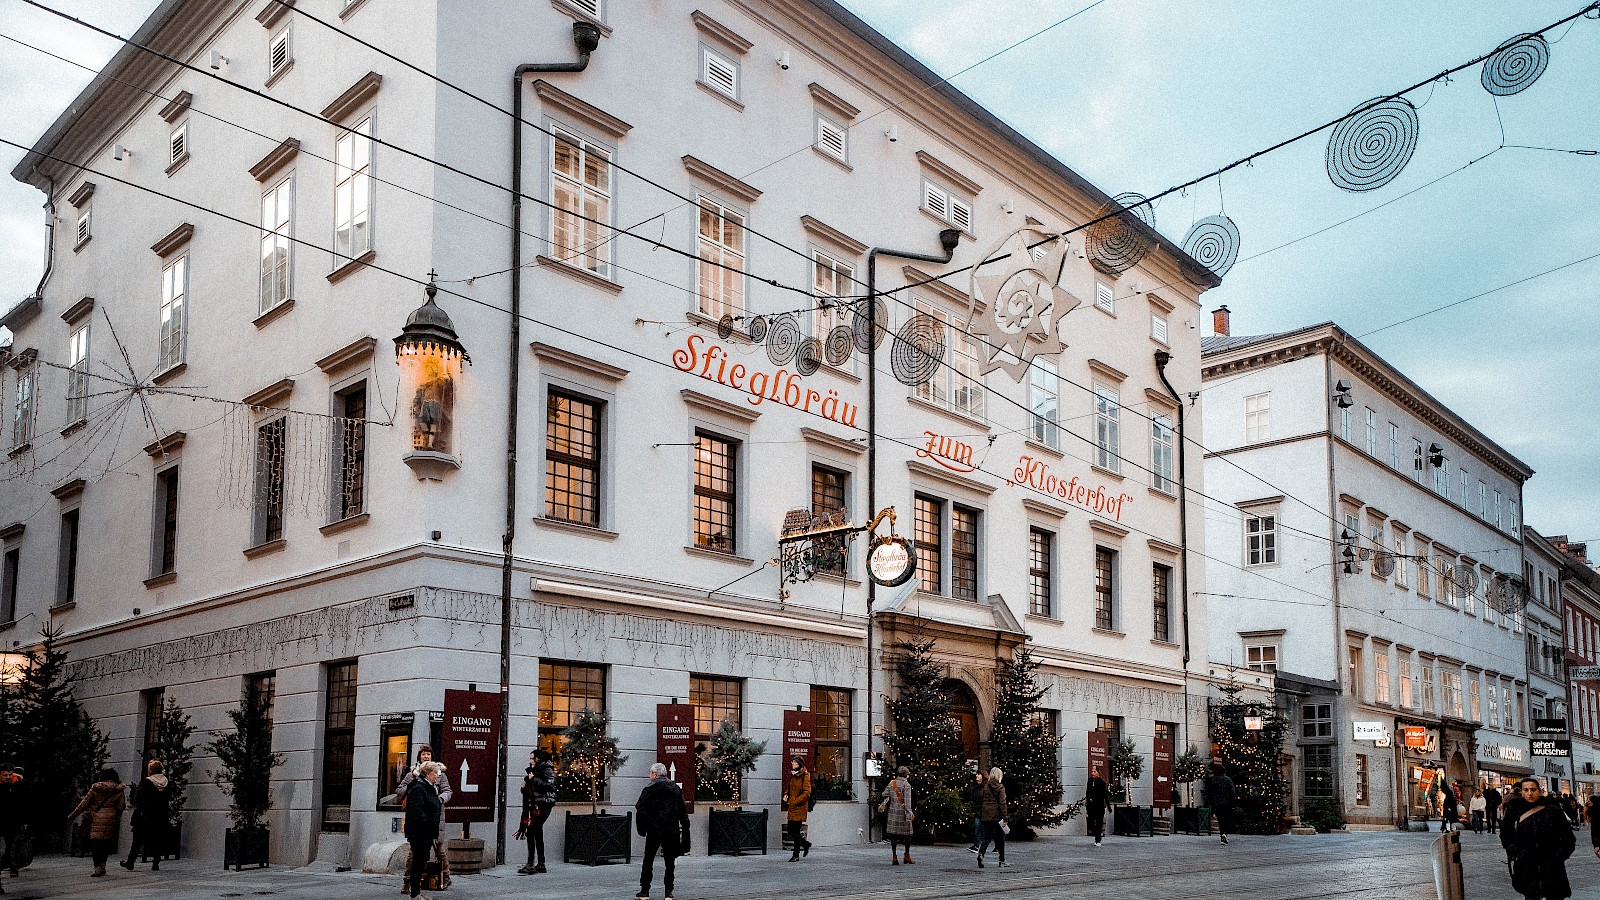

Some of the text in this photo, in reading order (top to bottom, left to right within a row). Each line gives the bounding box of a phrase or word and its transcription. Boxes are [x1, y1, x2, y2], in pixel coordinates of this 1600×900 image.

[672, 334, 858, 428] Stieglbräu
[452, 716, 492, 726] EINGANG
[662, 726, 690, 734] EINGANG
[1533, 748, 1569, 756] wutscher
